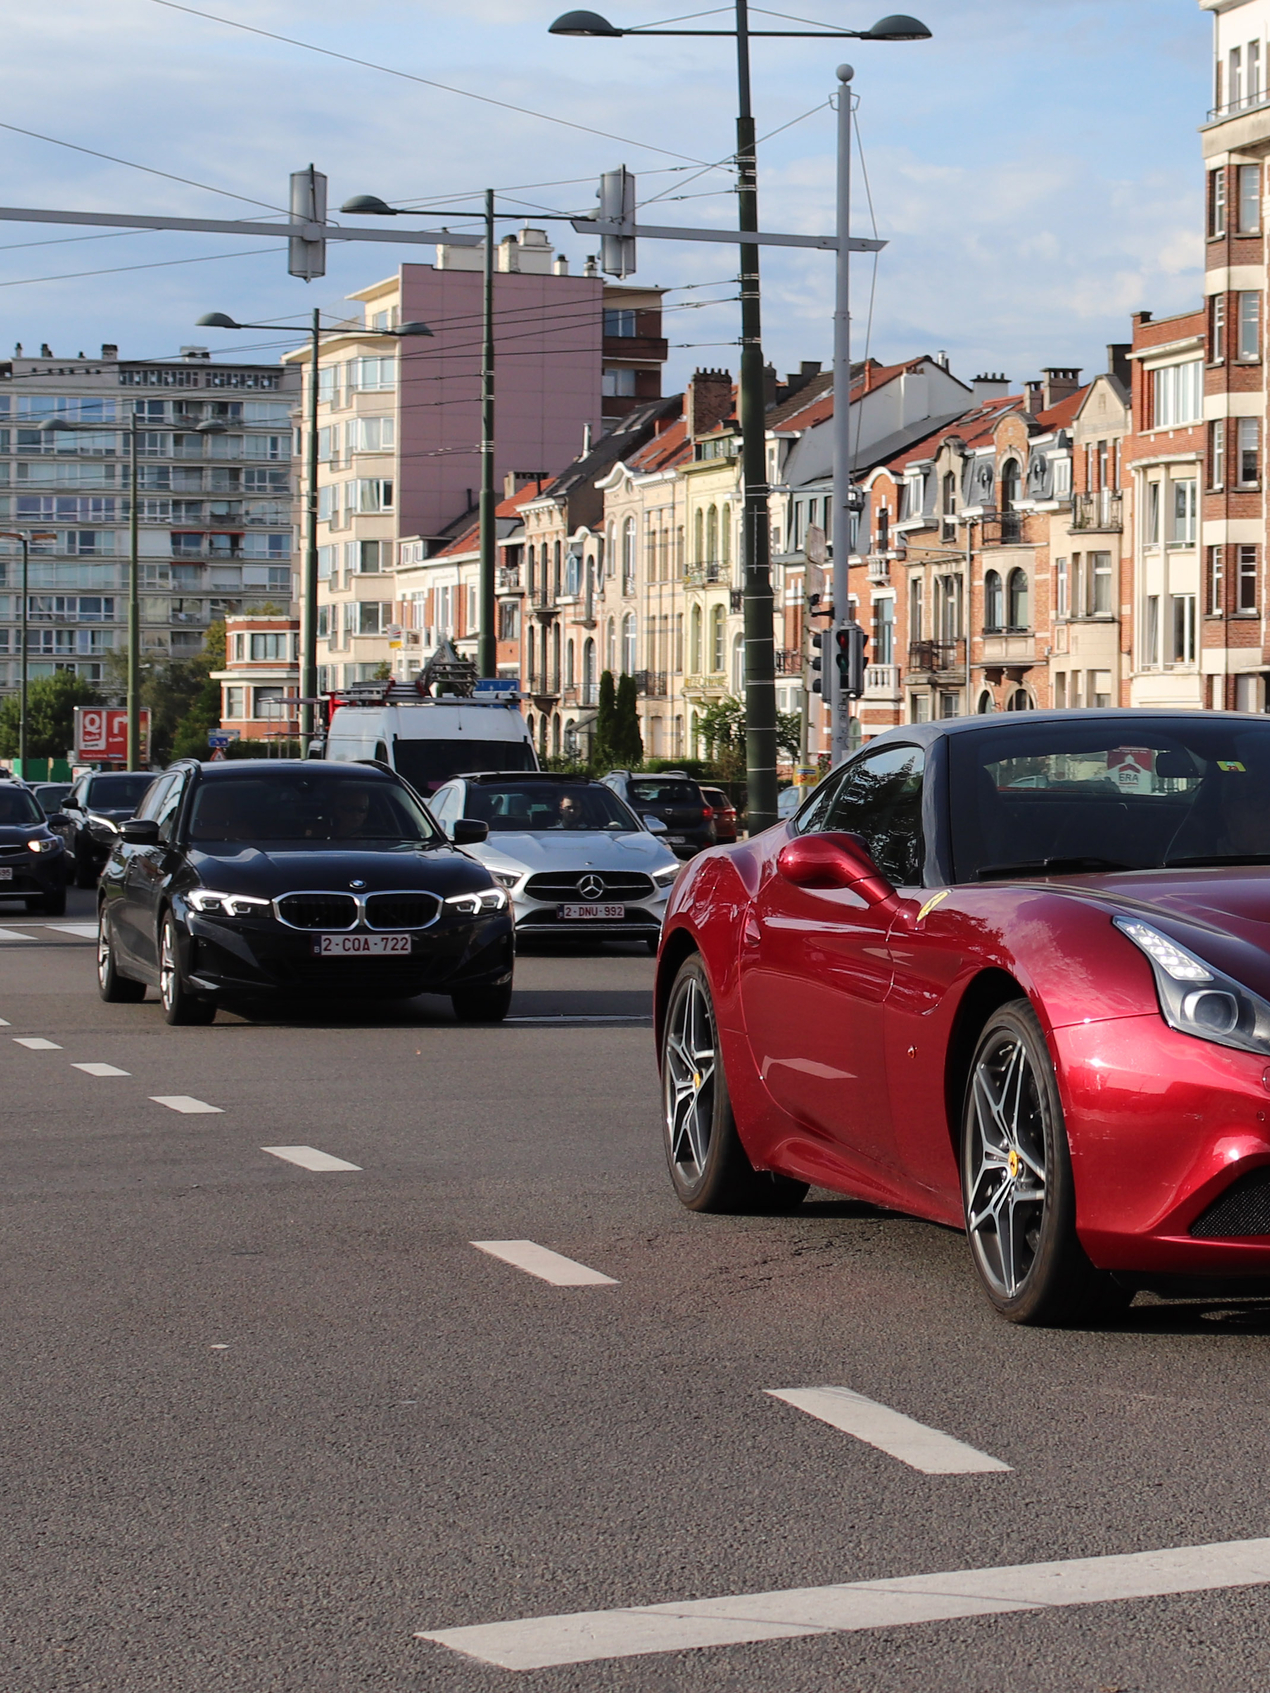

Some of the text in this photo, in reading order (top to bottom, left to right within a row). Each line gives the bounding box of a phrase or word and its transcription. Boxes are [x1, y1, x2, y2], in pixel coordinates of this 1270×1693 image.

[84, 713, 101, 734] Q
[1118, 773, 1139, 783] ERA
[565, 906, 623, 917] 2-DNU-992
